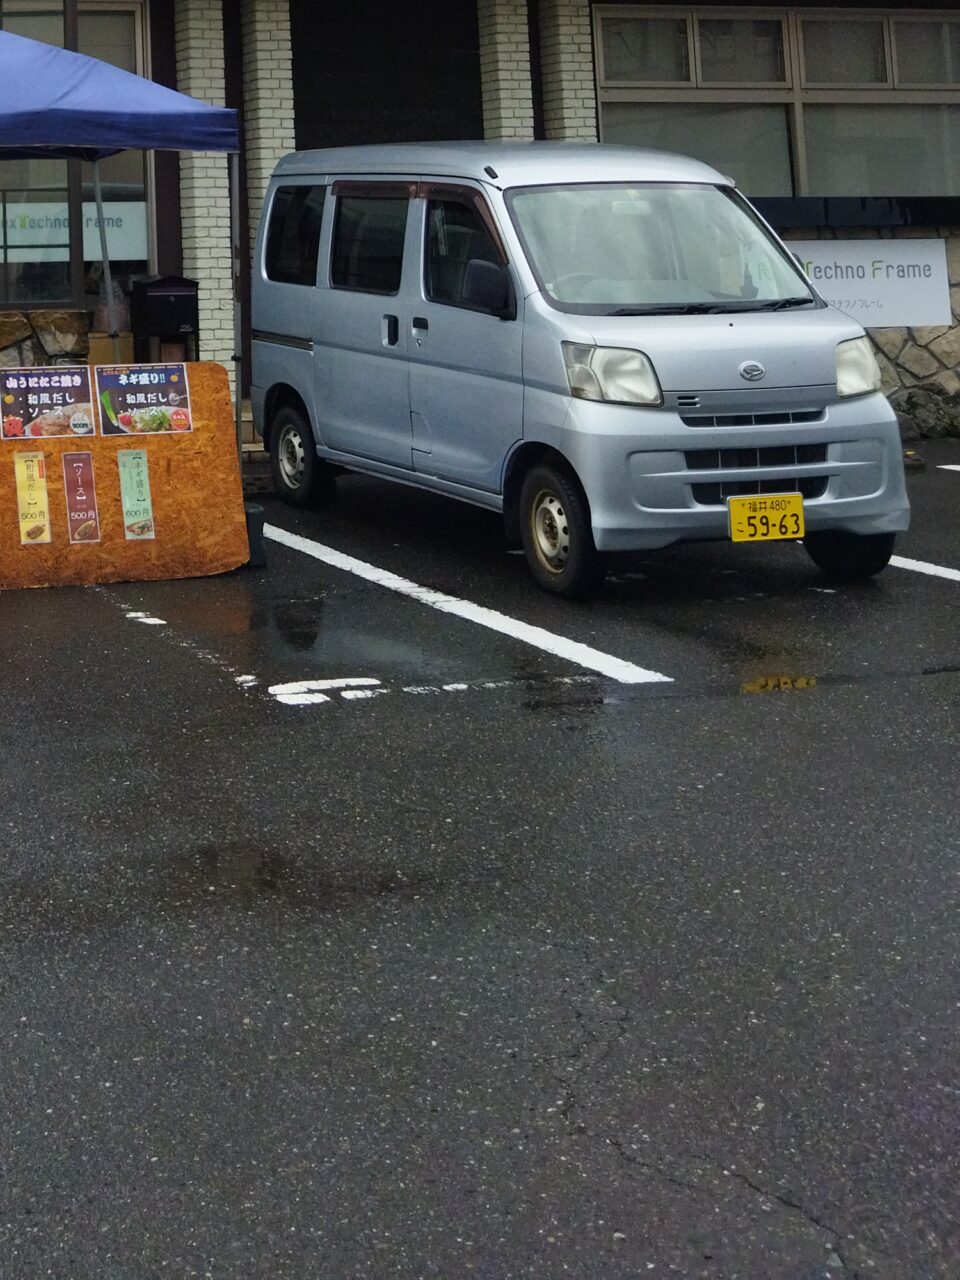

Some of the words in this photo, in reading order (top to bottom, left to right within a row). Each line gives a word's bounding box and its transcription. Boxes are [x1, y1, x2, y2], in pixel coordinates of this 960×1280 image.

[871, 260, 932, 279] Frame
[748, 501, 767, 512] 福井
[769, 499, 787, 511] 480
[737, 521, 744, 533] こ
[747, 513, 800, 537] 59-63
